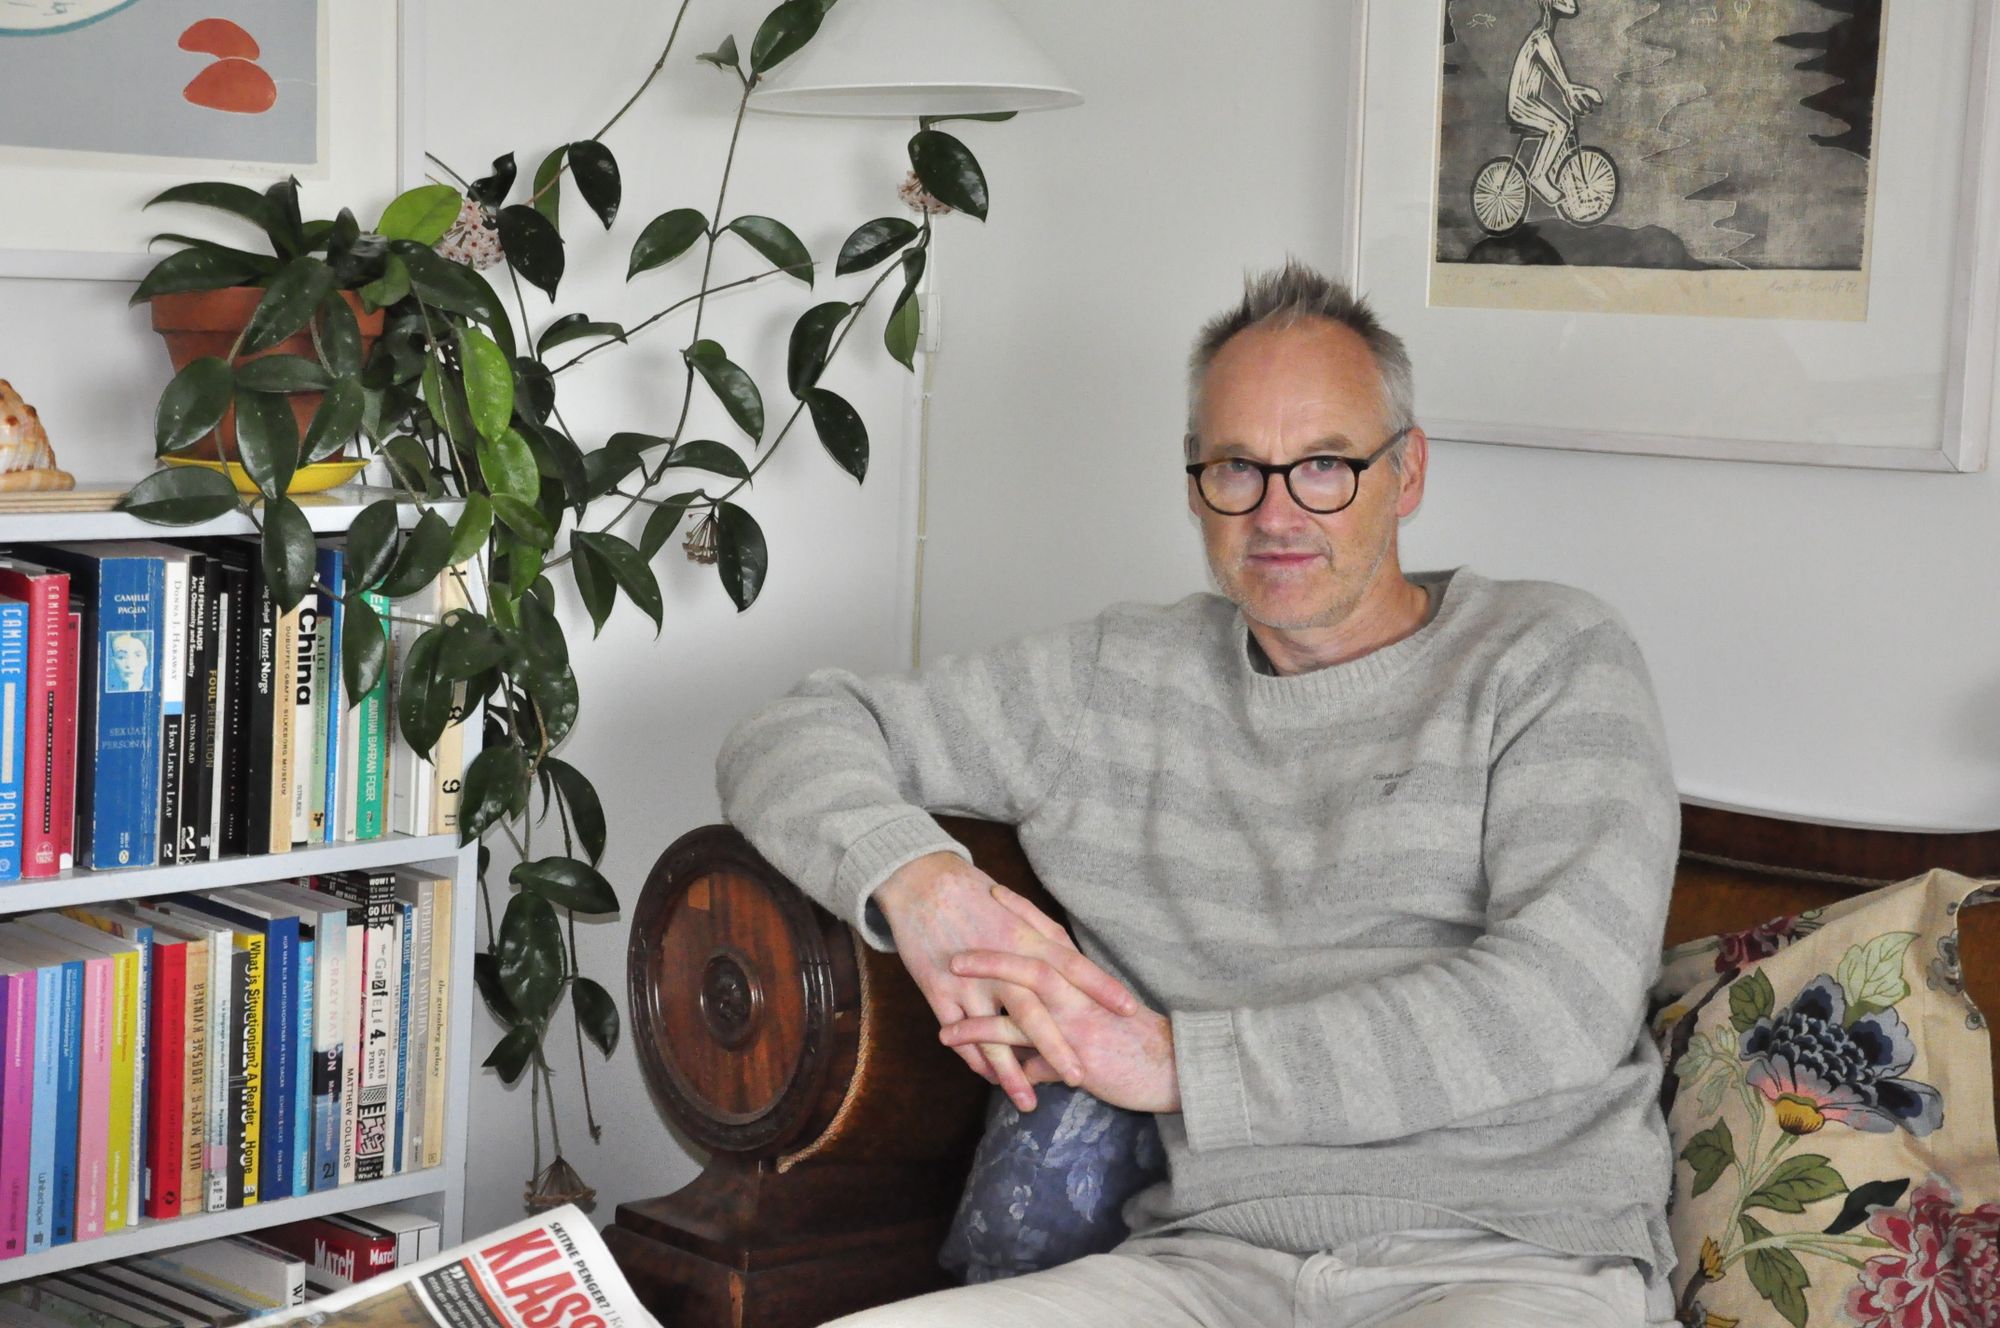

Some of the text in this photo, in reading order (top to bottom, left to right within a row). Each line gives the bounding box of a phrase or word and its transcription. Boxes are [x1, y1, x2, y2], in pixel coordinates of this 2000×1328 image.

[115, 594, 150, 603] CAMILLE
[118, 605, 147, 615] PAGLIA
[189, 592, 198, 628] Obscenity
[197, 594, 205, 626] FEMALE
[46, 586, 60, 687] CAMILLE PAGLIA
[284, 626, 292, 670] DUBUFFET
[316, 635, 327, 674] ALICE
[187, 644, 196, 678] Sexuality
[257, 628, 272, 695] Kunst-Norge
[296, 607, 318, 706] China
[0, 608, 22, 848] CAMILLE PAGLIA
[367, 696, 379, 734] JONATHAN
[188, 714, 197, 764] LYNDA NEAD
[366, 735, 378, 773] SAFRAN
[365, 774, 376, 802] FOER
[443, 779, 461, 795] 9
[368, 907, 380, 916] GO
[249, 940, 261, 971] What
[417, 892, 433, 1037] EXPERIMENTAL ANIMATION
[249, 975, 260, 985] is
[302, 979, 313, 1004] ART
[329, 957, 340, 1006] CRAZY
[247, 988, 261, 1068] Situationism?
[302, 1007, 313, 1039] NOW
[431, 979, 446, 1078] the gutenberg galaxy
[191, 1037, 204, 1085] NORSKE
[246, 1072, 258, 1082] A
[245, 1085, 258, 1126] Reader
[343, 1067, 355, 1169] MATTHEW COLLINGS
[190, 1142, 203, 1171] ULLA
[244, 1140, 257, 1175] Home
[36, 1172, 48, 1226] Whitechapel
[315, 1237, 355, 1282] MATCH
[548, 1222, 582, 1259] SKITNE
[573, 1260, 612, 1310] PENGER?
[427, 1276, 442, 1293] enn
[436, 1292, 448, 1303] en
